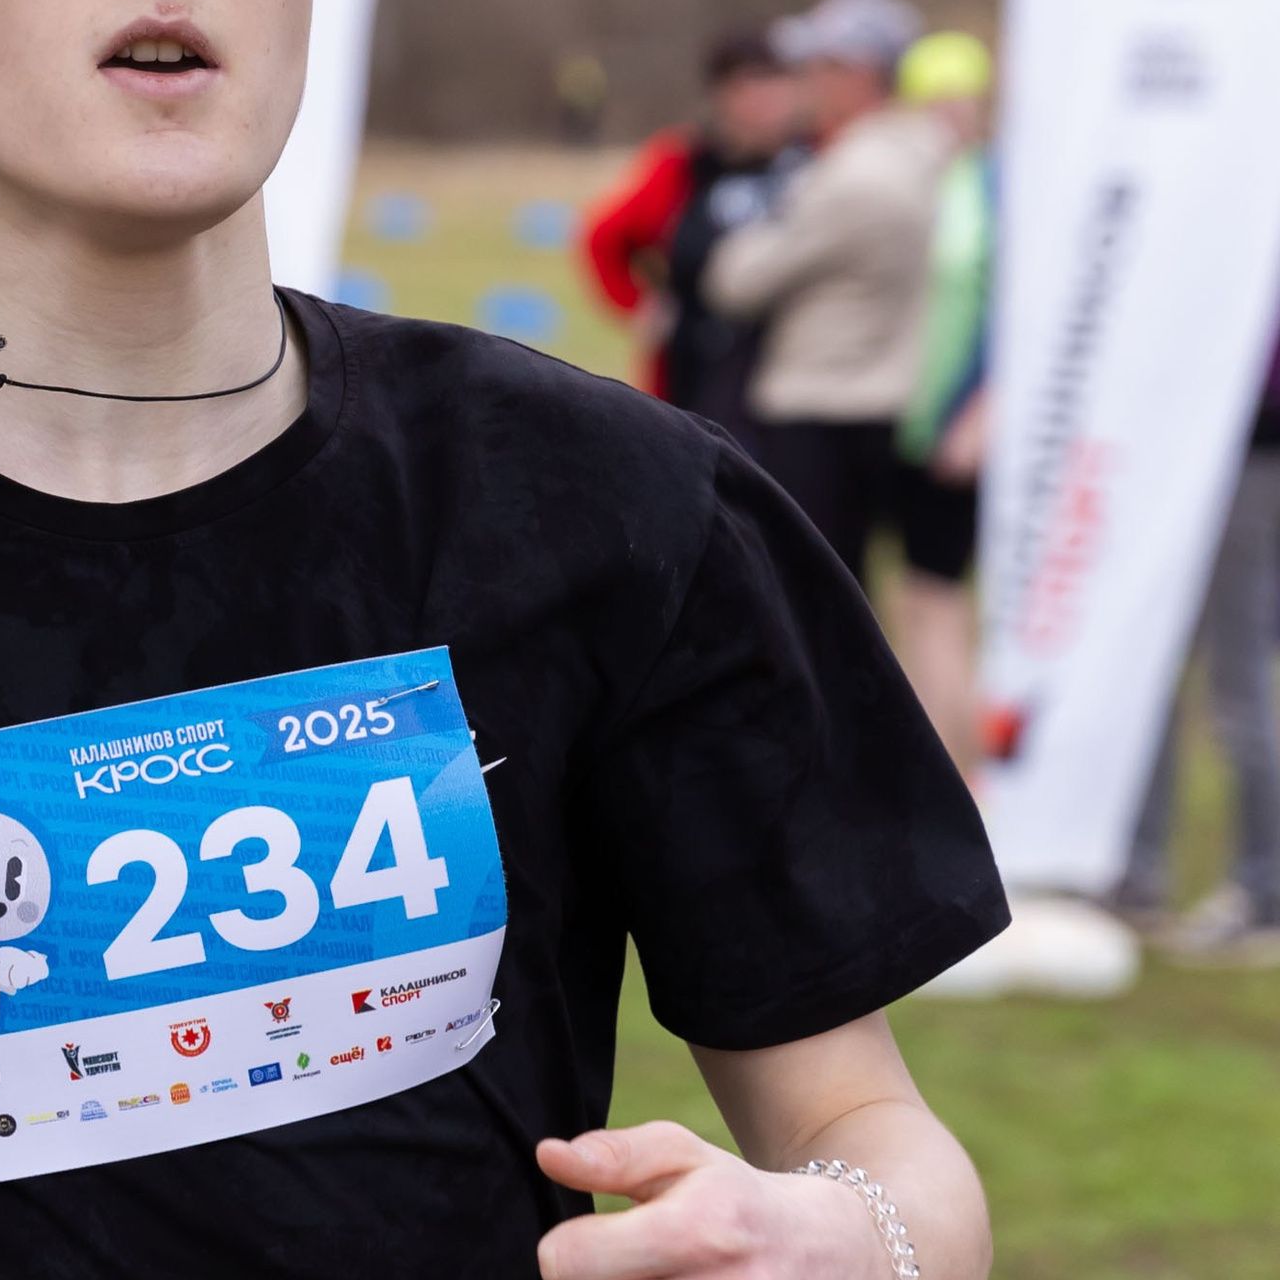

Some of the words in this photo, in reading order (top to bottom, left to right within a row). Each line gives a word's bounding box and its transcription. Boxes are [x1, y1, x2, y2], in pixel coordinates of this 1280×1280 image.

[70, 730, 174, 766] КАЛАШНИКОВ
[176, 719, 224, 745] СПОРТ
[278, 698, 395, 753] 2025
[74, 743, 234, 799] КРОСС
[86, 775, 450, 981] 234
[379, 968, 468, 997] КАЛАШНИКОВ
[381, 989, 422, 1008] СПОРТ
[330, 1046, 365, 1066] ещё!
